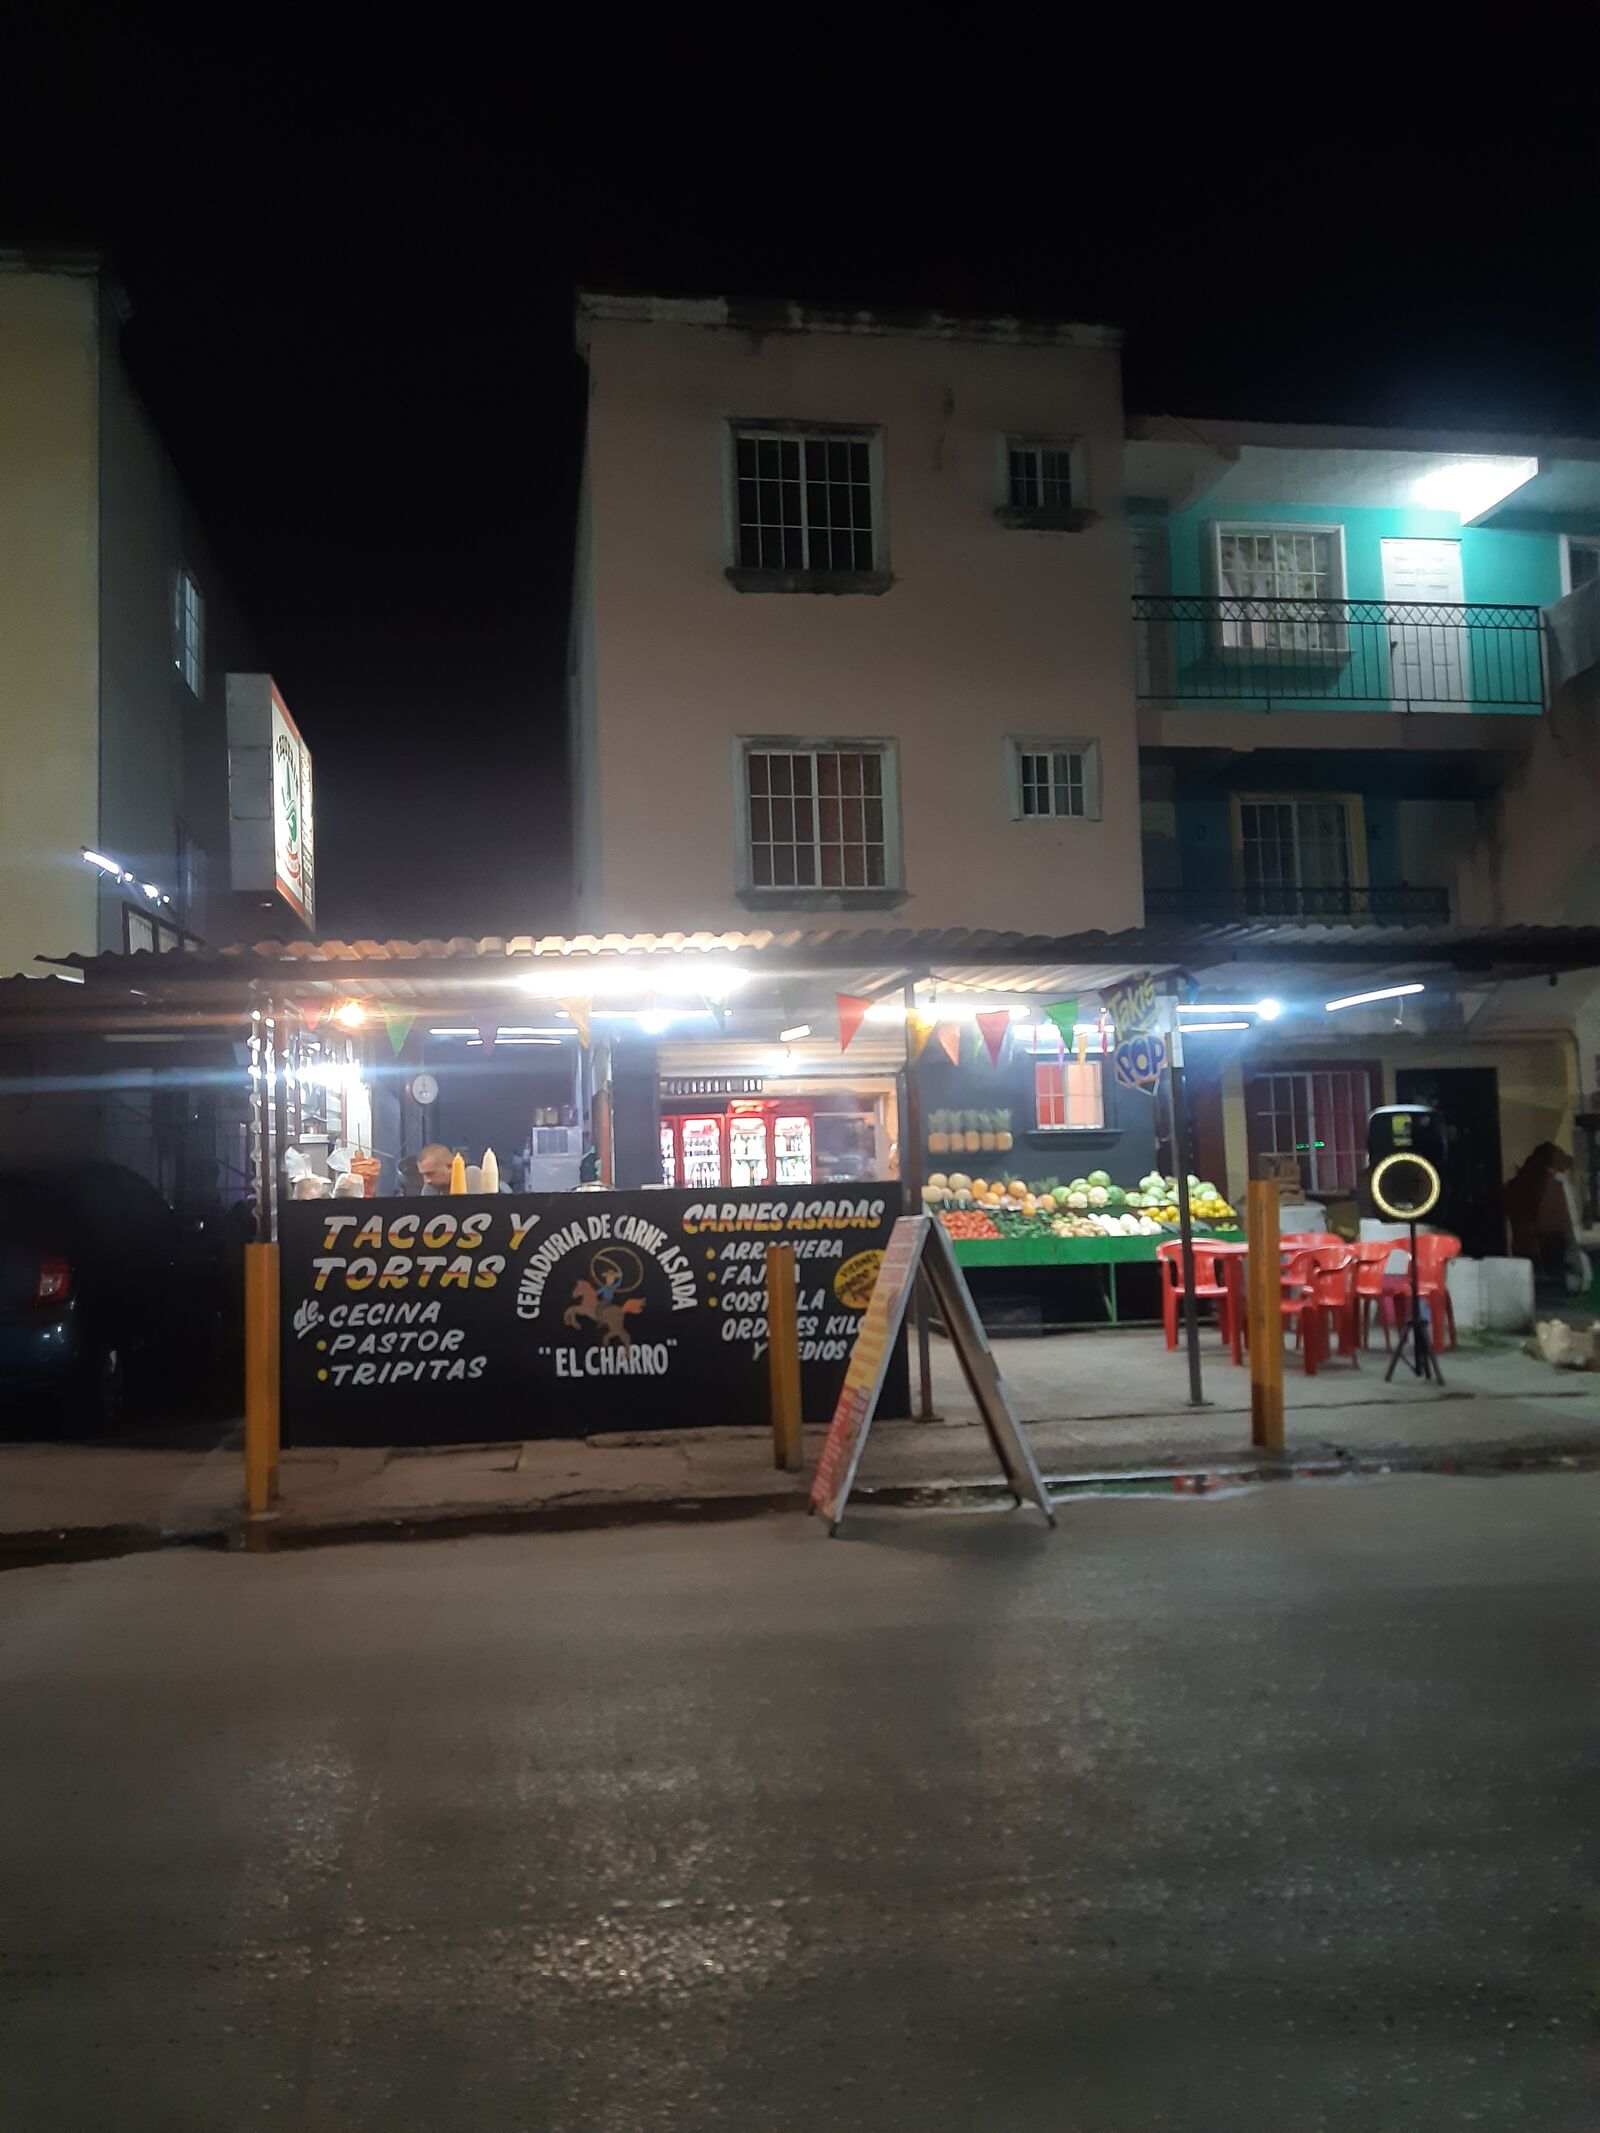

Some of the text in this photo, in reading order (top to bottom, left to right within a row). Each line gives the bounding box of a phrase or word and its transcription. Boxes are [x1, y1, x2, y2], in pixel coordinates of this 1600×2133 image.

[682, 1199, 885, 1234] CARNES ASADAS
[323, 1212, 540, 1250] TACOS Y
[719, 1240, 843, 1261] ARRHERA
[312, 1255, 506, 1291] TORTAS
[516, 1213, 698, 1319] CENADURIA DE CARNE ASADA
[721, 1288, 826, 1312] COSTLA
[329, 1301, 441, 1328] CECINA
[330, 1329, 465, 1355] PASTOR
[721, 1316, 819, 1341] ORDES
[797, 1338, 848, 1361] EDIOS
[331, 1356, 487, 1386] TRIPITAS
